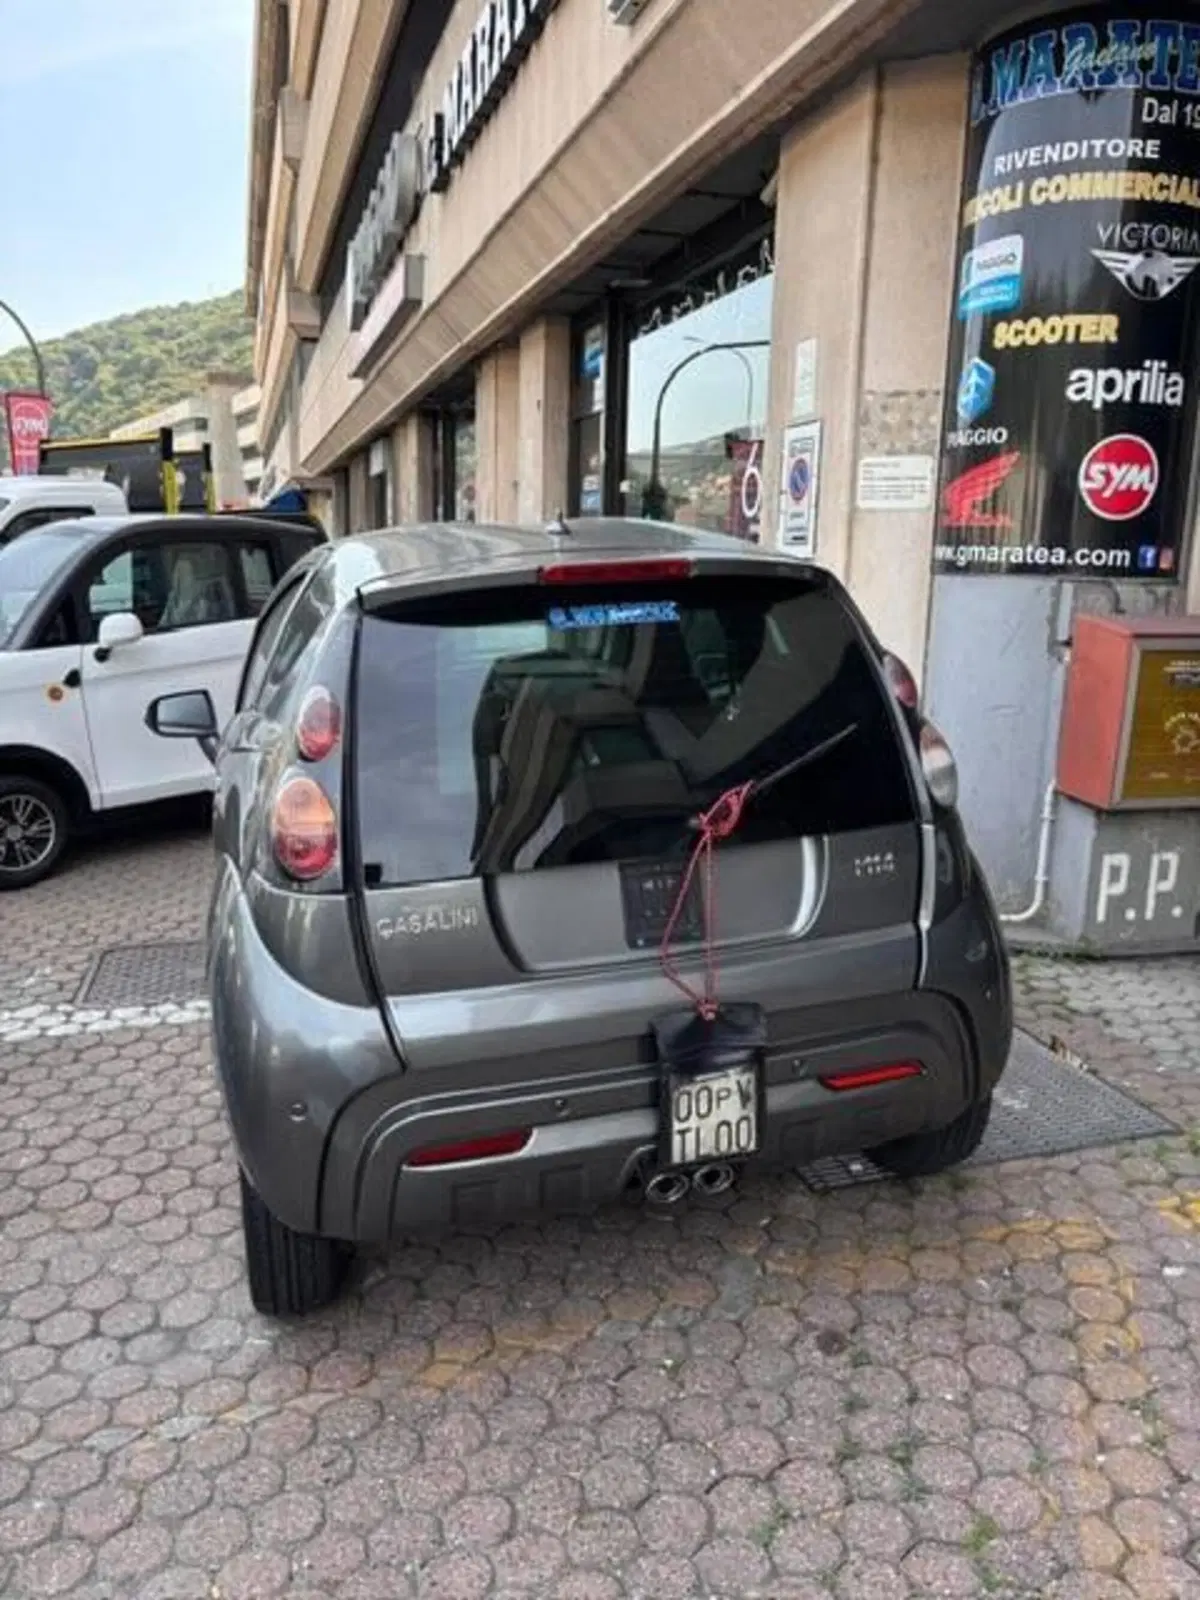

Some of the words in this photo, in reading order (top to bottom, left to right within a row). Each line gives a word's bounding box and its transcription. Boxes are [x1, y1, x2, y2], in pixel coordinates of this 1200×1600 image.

[1142, 97, 1178, 126] Dal
[993, 138, 1161, 177] RIVENDITORE
[1097, 221, 1200, 250] VICTORIA
[993, 314, 1119, 349] SCOOTER
[1066, 360, 1185, 409] aprilia
[1081, 462, 1152, 499] SYM
